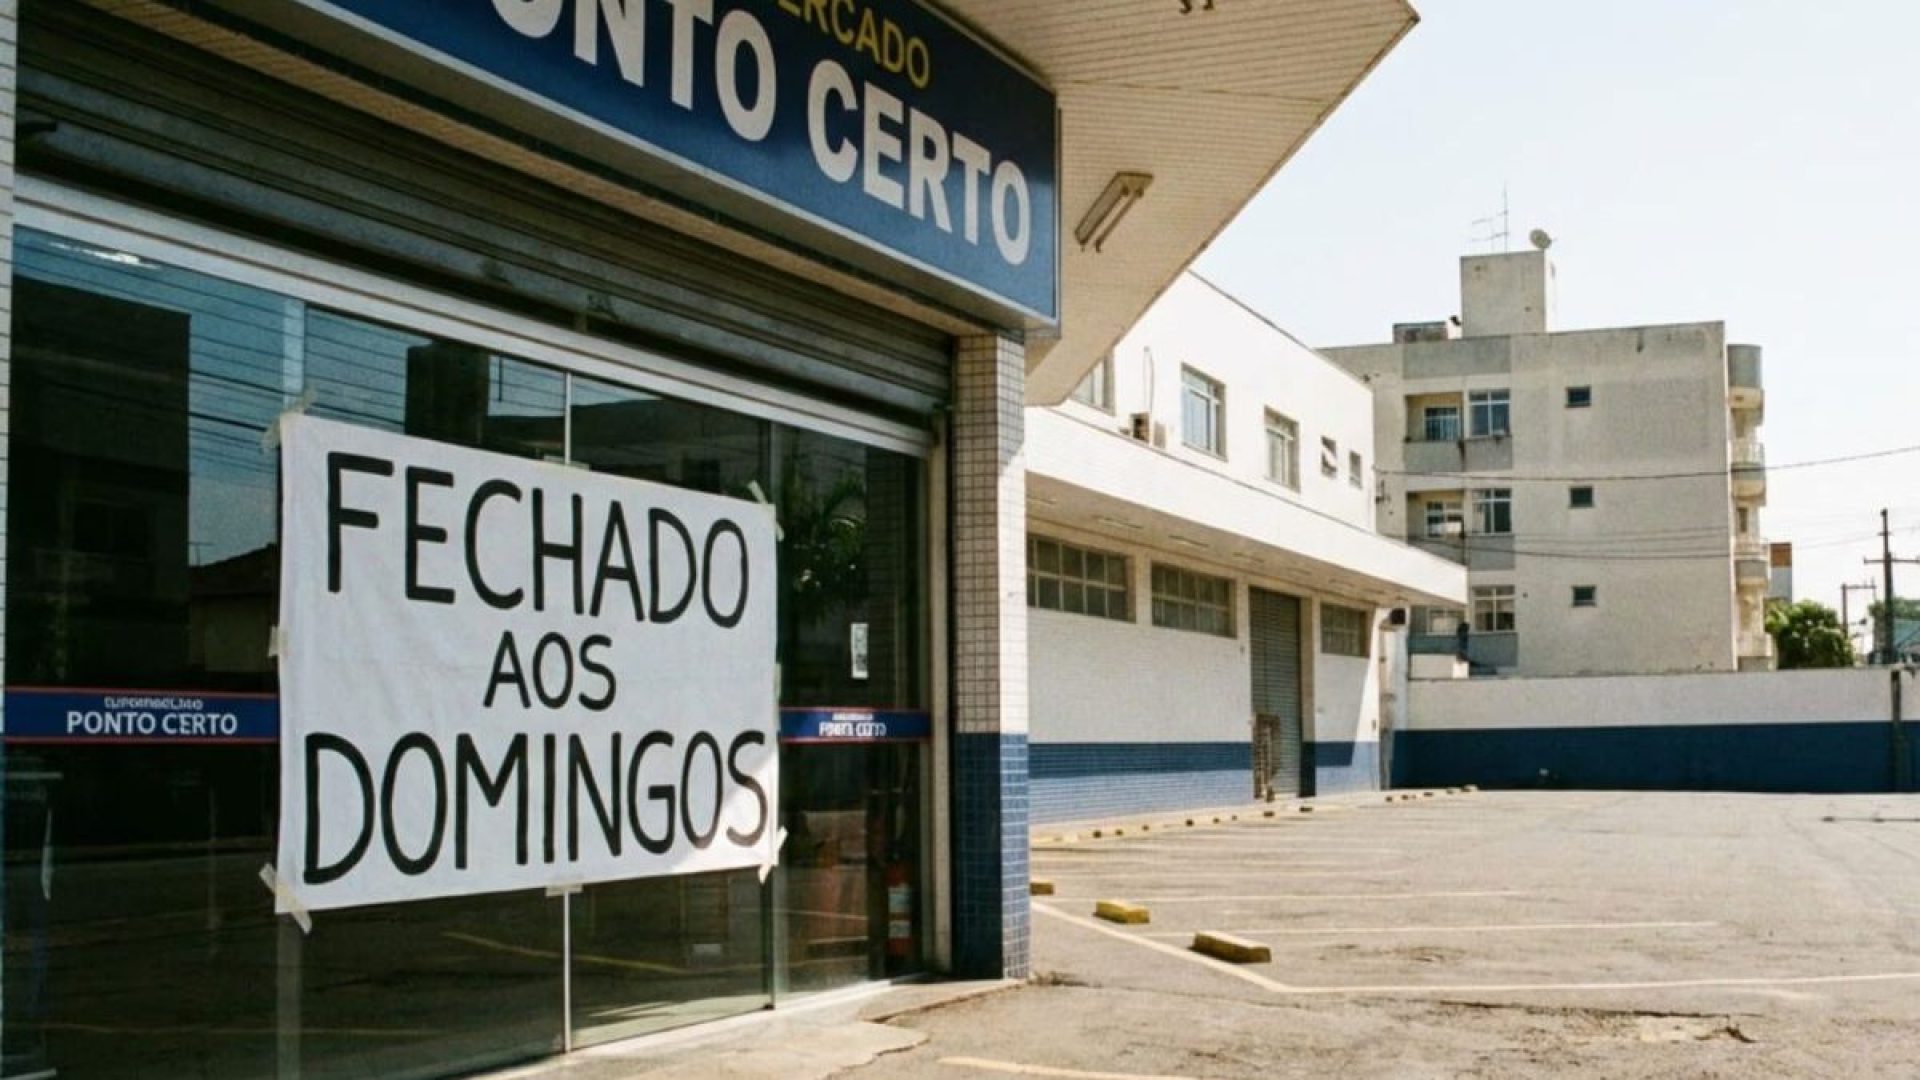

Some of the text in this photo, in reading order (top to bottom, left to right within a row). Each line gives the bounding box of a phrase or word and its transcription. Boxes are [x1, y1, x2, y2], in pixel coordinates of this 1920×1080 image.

[778, 0, 929, 88] RCADO
[492, 0, 1030, 265] NTO CERTO
[327, 451, 749, 628] FECHADO
[67, 711, 238, 735] PONTO CERTO
[483, 630, 616, 710] AOS
[303, 730, 768, 884] DOMINGOS
